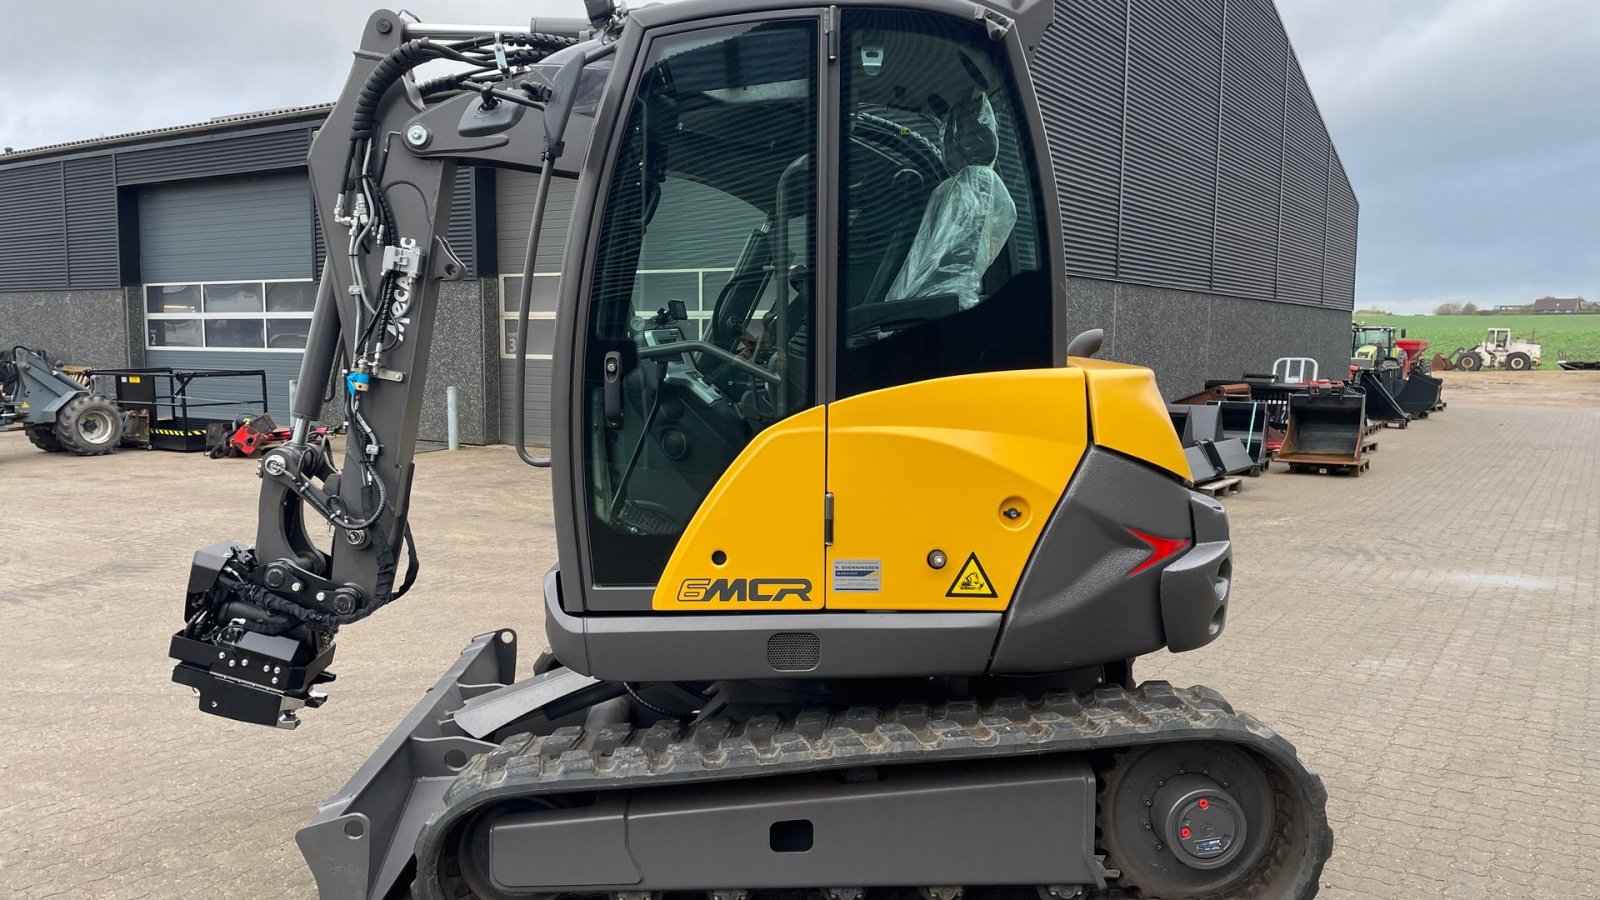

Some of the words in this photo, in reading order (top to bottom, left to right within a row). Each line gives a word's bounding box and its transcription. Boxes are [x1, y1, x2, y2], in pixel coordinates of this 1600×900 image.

[151, 334, 156, 345] 2
[509, 338, 517, 352] 3
[677, 578, 812, 602] 6MCR
